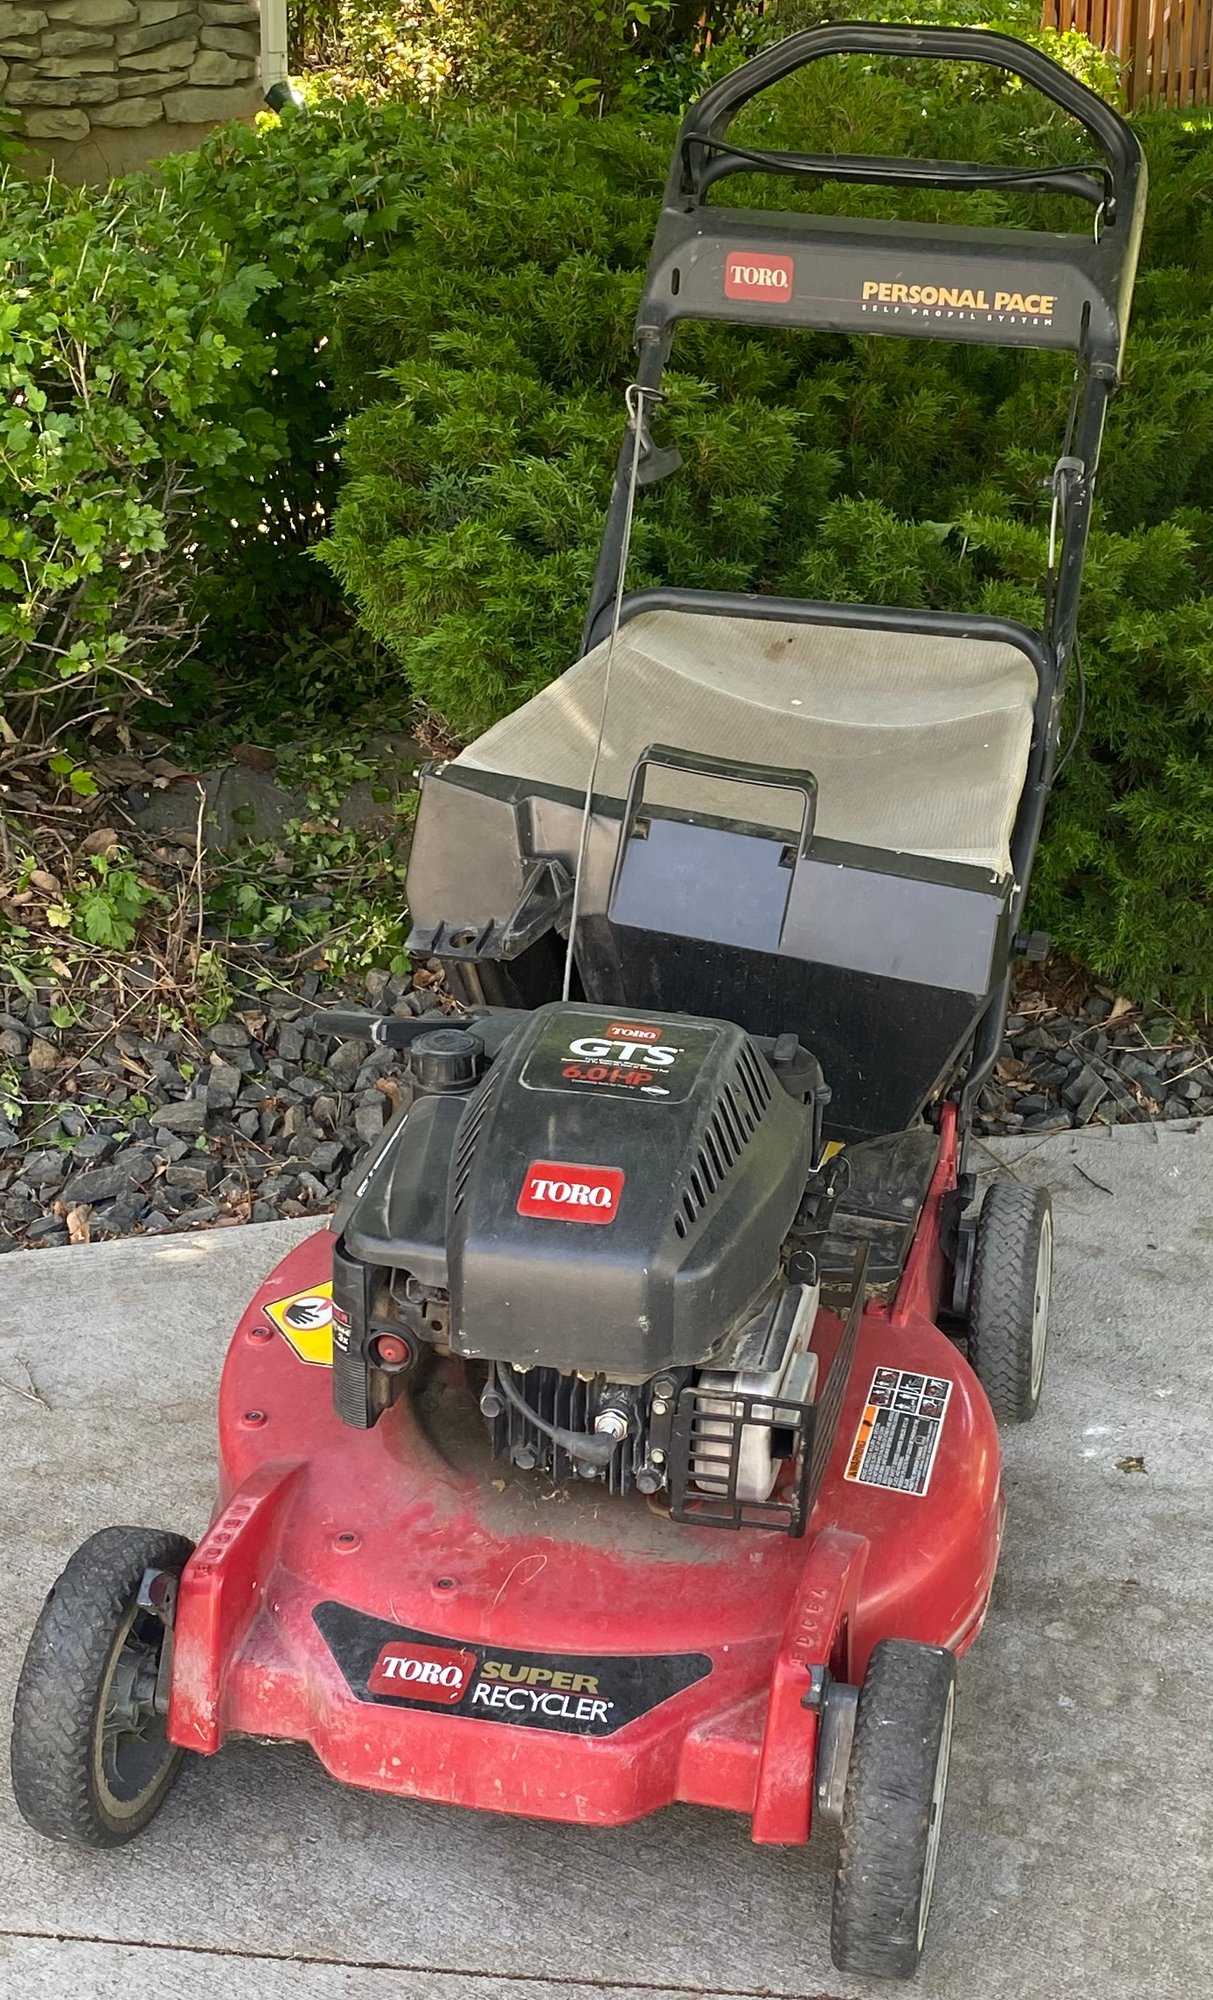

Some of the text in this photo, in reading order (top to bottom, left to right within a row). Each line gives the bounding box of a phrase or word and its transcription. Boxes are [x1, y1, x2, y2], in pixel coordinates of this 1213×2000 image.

[731, 265, 788, 288] TORO
[862, 281, 1055, 315] PERSONAL PACE
[862, 304, 1053, 326] SELF PROPEL SYSTEM
[611, 1027, 657, 1039] TORO
[569, 1037, 680, 1066] GTS
[530, 1179, 613, 1209] TORO
[382, 1656, 463, 1689] TORO
[479, 1660, 600, 1695] SUPER
[471, 1682, 609, 1724] RECYCLER
